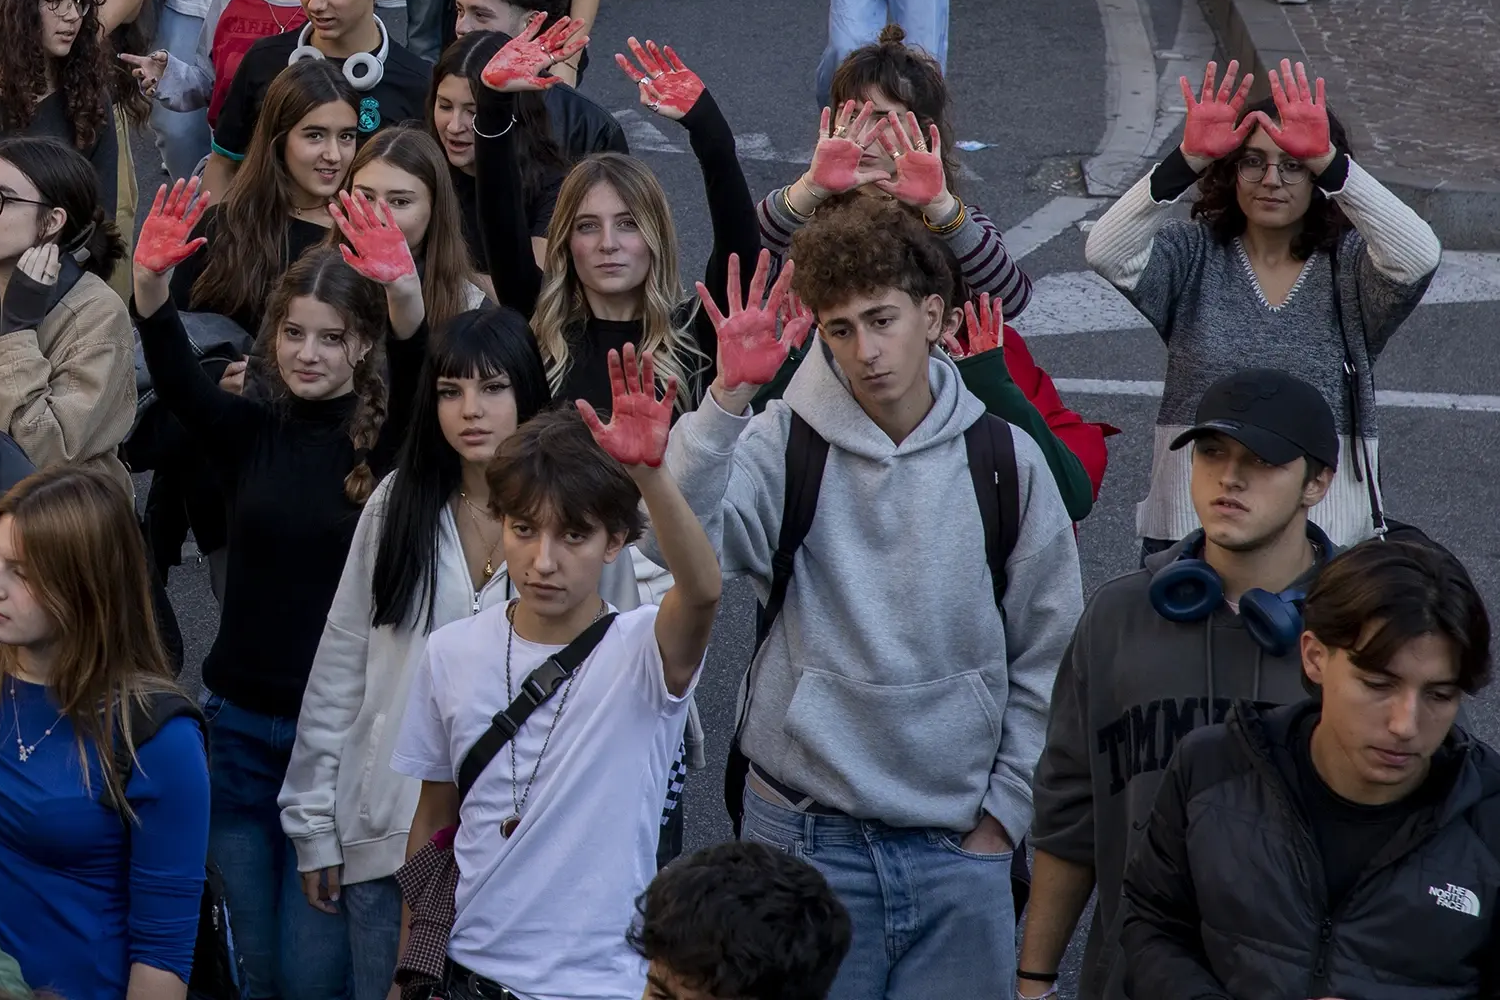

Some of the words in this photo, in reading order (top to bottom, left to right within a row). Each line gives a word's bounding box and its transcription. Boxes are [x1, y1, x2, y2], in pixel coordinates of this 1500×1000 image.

[1428, 885, 1464, 904] NORTH
[1445, 882, 1466, 896] THE
[1435, 897, 1464, 912] FACE
